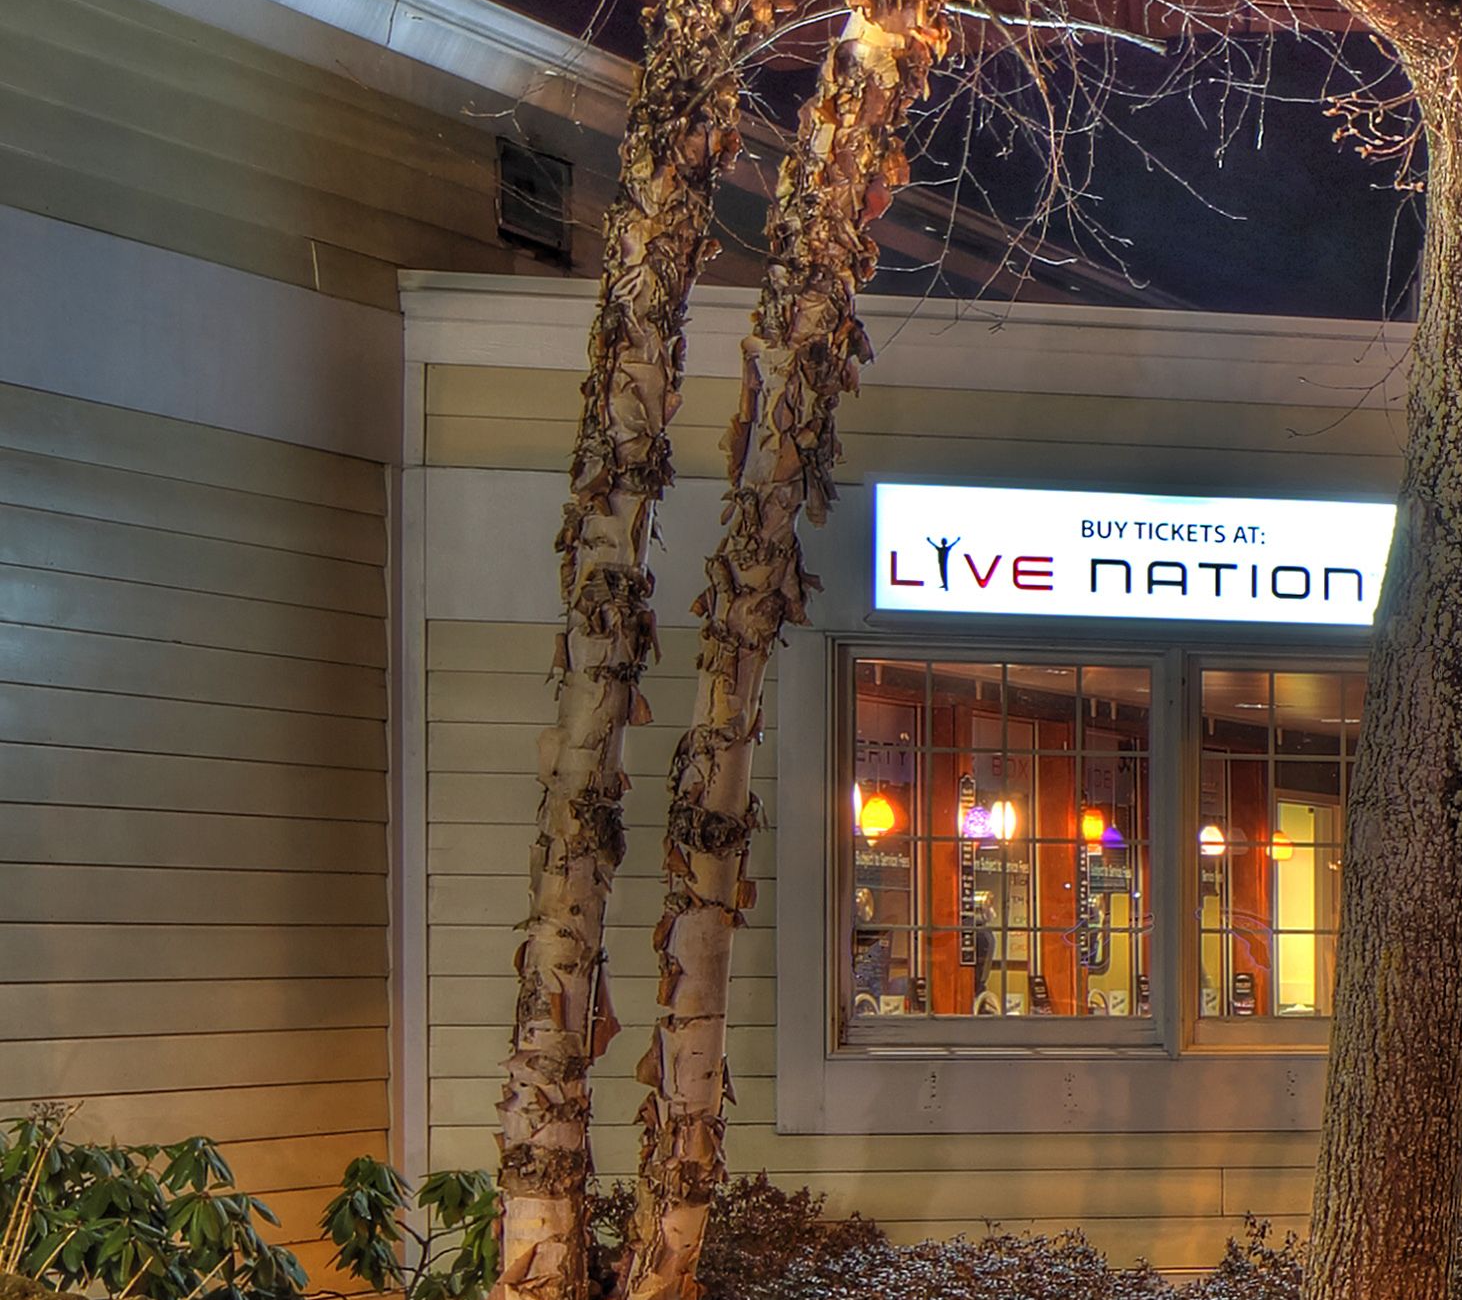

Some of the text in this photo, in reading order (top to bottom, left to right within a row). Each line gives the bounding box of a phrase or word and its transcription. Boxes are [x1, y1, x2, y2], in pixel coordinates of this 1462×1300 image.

[1081, 519, 1267, 546] BUY TICKETS AT:
[1090, 557, 1364, 602] NATION
